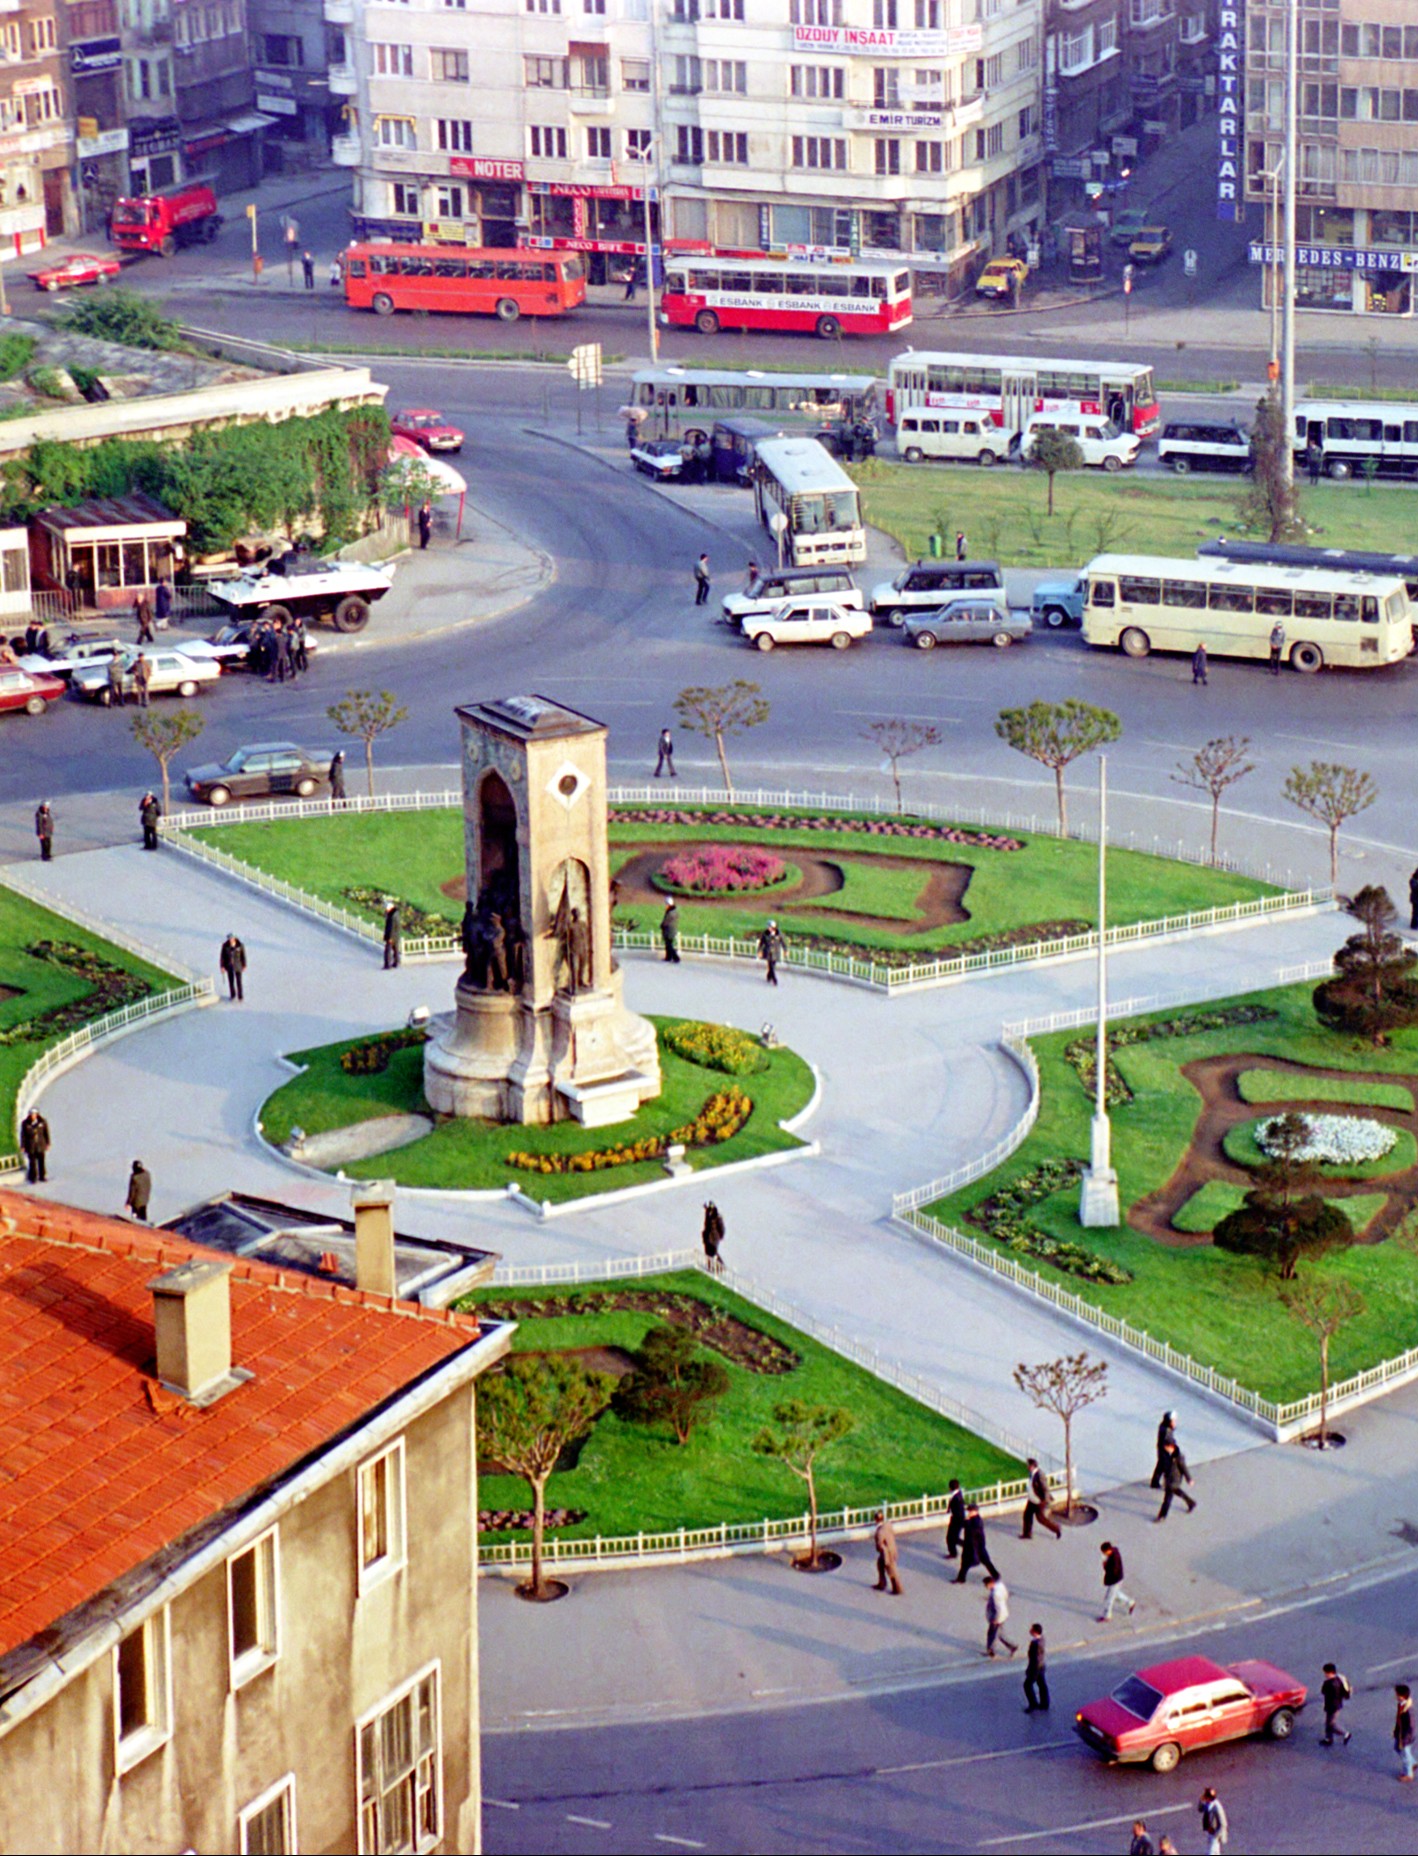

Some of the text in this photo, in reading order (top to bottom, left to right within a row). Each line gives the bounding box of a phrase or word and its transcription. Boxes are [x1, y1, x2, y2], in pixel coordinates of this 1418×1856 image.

[474, 161, 522, 178] NOTER
[1251, 247, 1399, 269] MEREDES-BENZ
[720, 297, 876, 313] ESBANK ESBANK ESBANK
